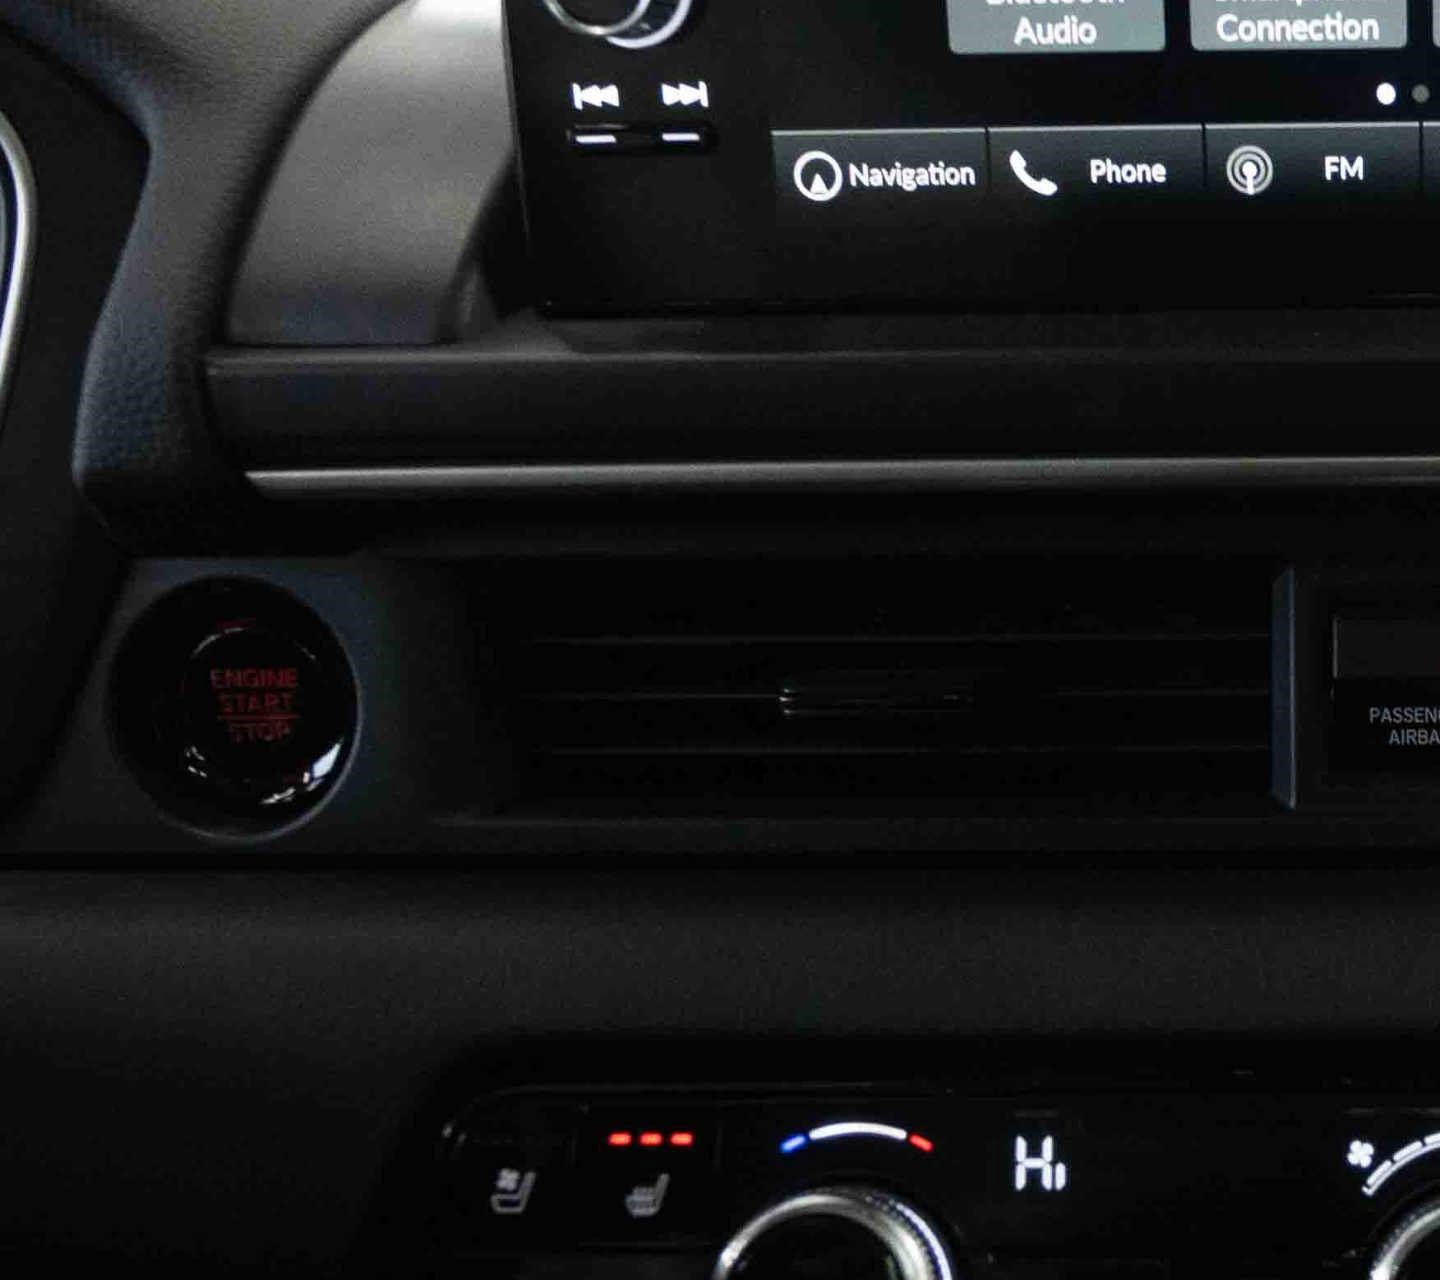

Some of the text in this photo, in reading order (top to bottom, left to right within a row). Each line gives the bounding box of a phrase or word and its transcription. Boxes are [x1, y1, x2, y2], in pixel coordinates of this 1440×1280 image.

[1015, 15, 1096, 45] Audio
[1217, 15, 1379, 43] Connection
[849, 161, 975, 189] Navigation
[1090, 159, 1166, 184] Phone
[1324, 157, 1364, 180] FM
[211, 670, 297, 687] ENGINE
[221, 694, 293, 712] START
